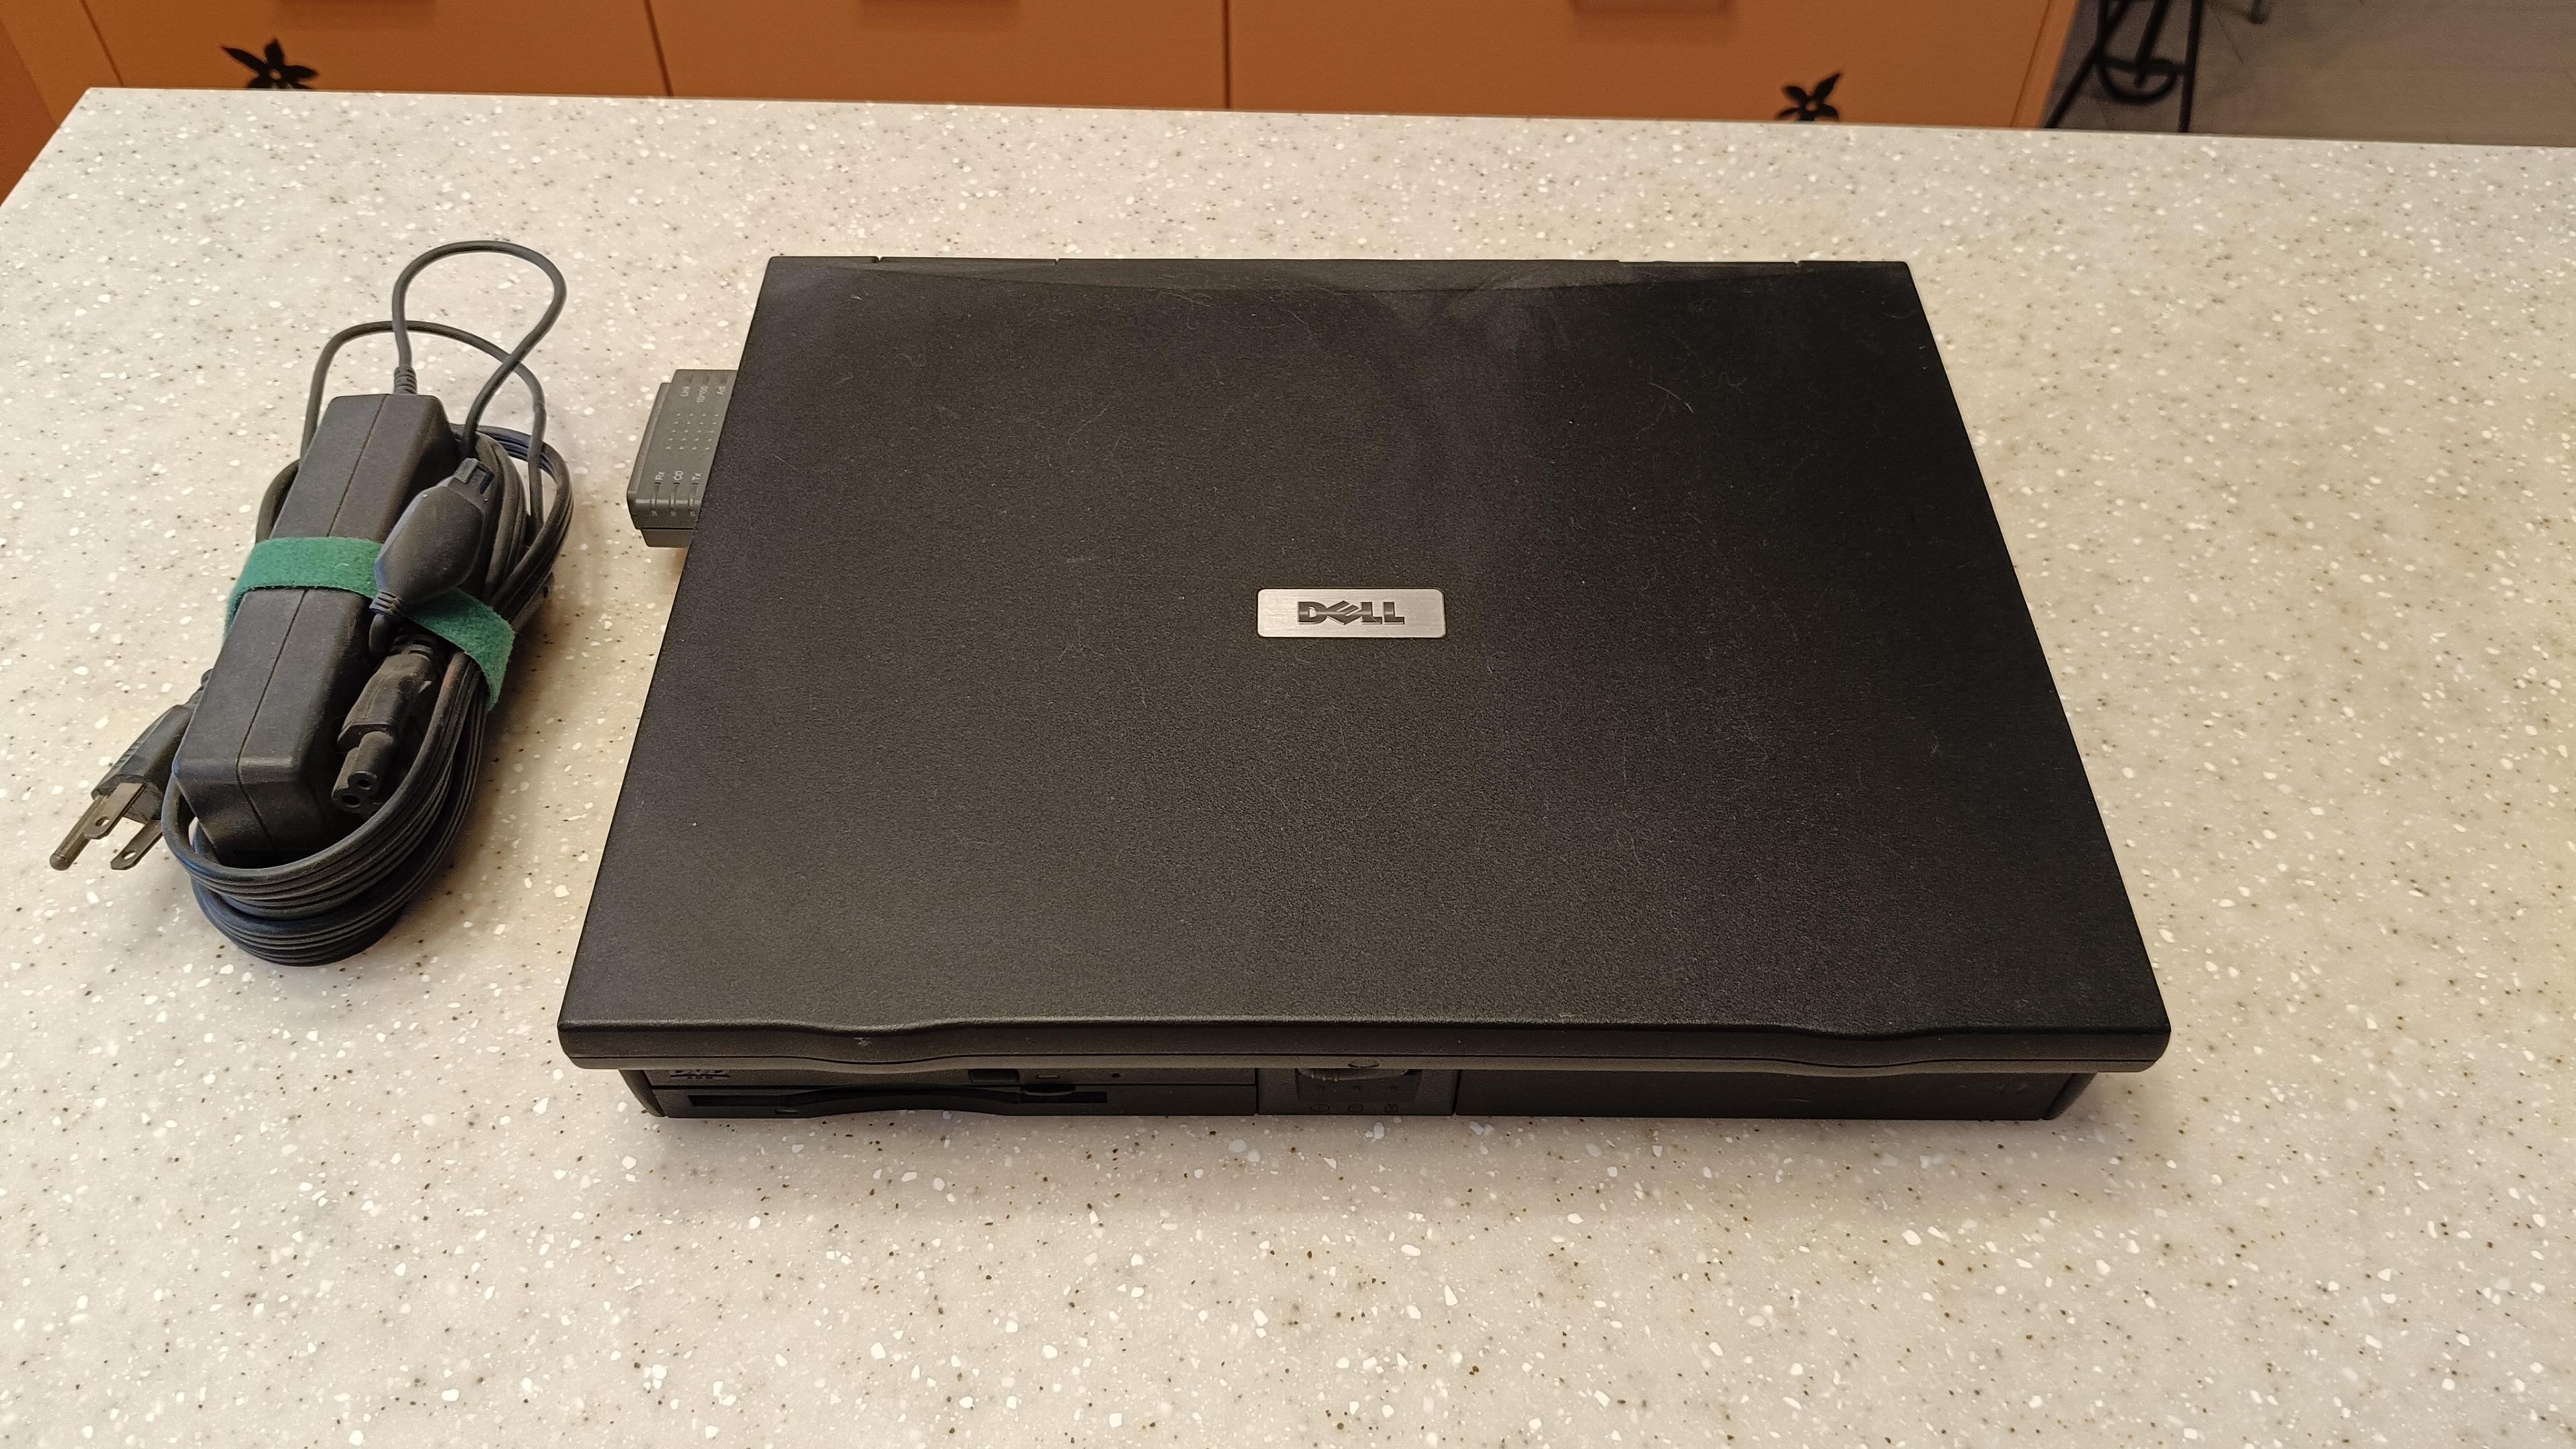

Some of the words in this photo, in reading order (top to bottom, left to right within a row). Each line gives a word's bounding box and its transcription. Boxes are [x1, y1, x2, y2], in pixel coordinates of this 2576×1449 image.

[655, 471, 665, 480] Rx
[673, 470, 684, 480] CD
[692, 472, 702, 481] Tx
[1297, 600, 1405, 625] DELL
